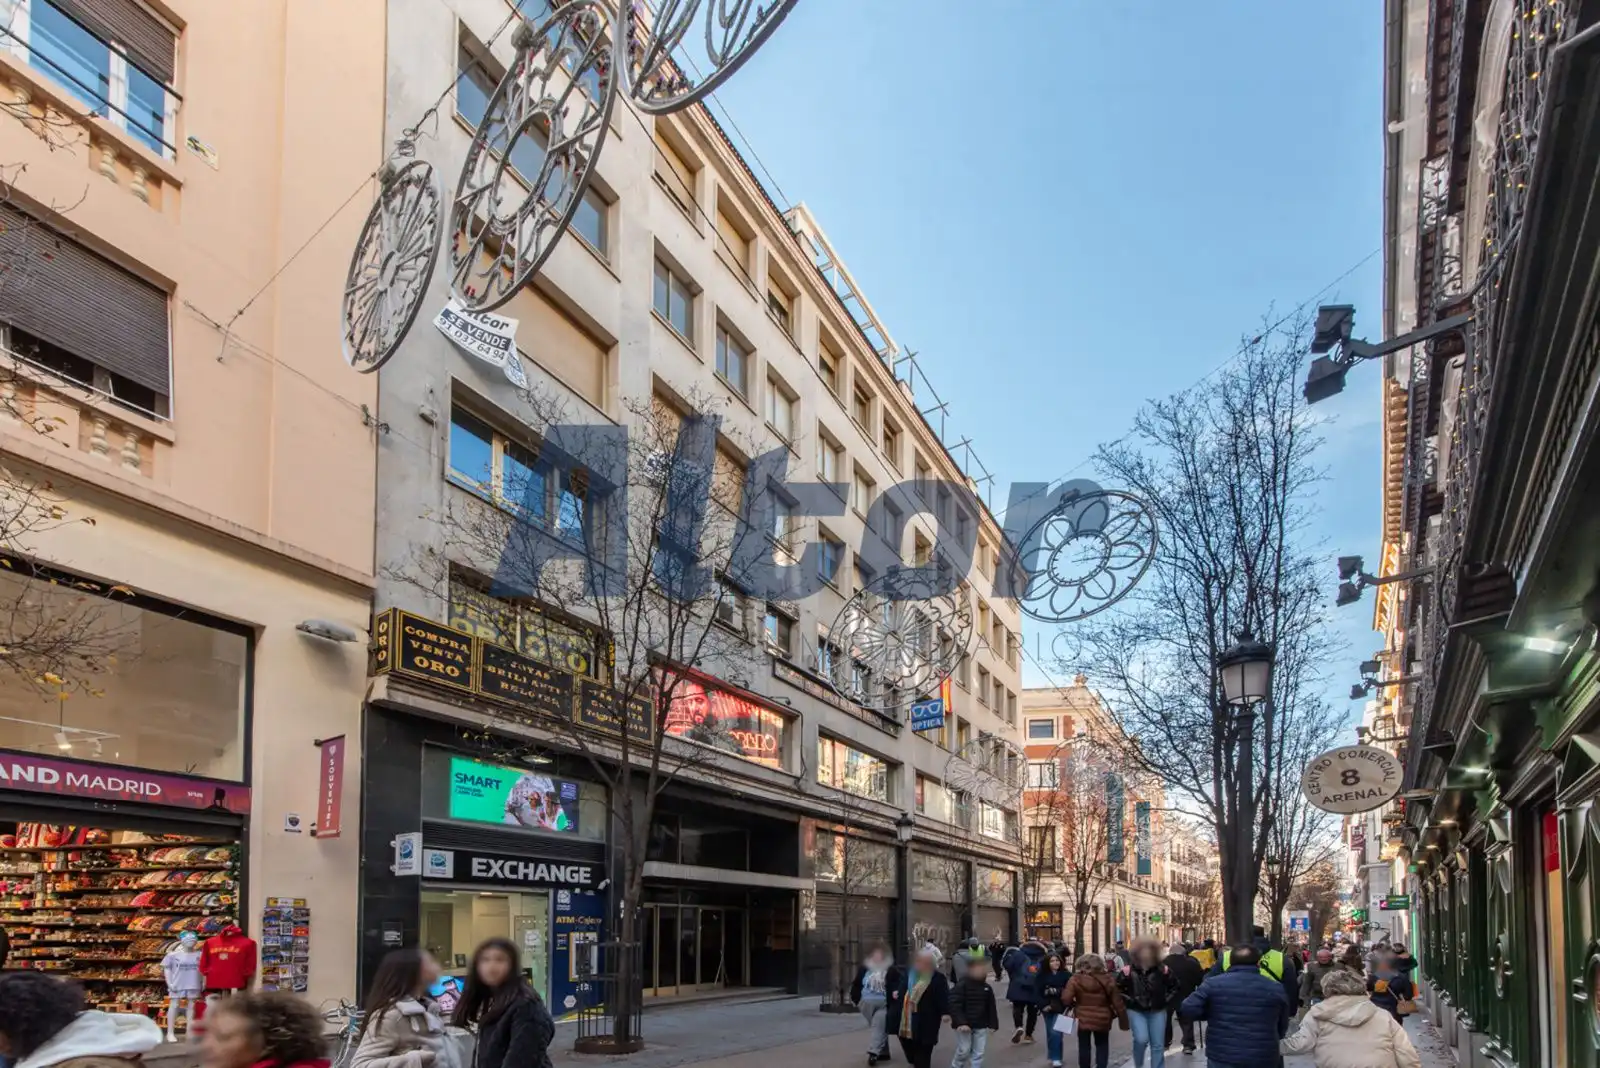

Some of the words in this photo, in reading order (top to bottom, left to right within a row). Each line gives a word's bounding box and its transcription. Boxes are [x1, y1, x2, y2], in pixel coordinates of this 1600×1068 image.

[440, 317, 453, 330] 91
[454, 330, 476, 346] 037
[477, 342, 491, 355] 64
[492, 349, 506, 360] 94
[448, 313, 465, 328] SE
[468, 324, 508, 349] VENDE
[377, 621, 389, 661] ORO
[404, 625, 470, 655] COMPRA
[410, 639, 465, 664] VENTA
[413, 656, 460, 677] ORO
[1308, 758, 1332, 796] CENTRO
[1338, 750, 1396, 783] COMERCIAL
[1341, 769, 1360, 786] 8
[66, 772, 161, 796] MADRID
[325, 758, 335, 828] SOUVENIRS
[455, 772, 502, 790] SMART
[1322, 787, 1388, 804] ARENAL
[471, 857, 592, 884] EXCHANGE
